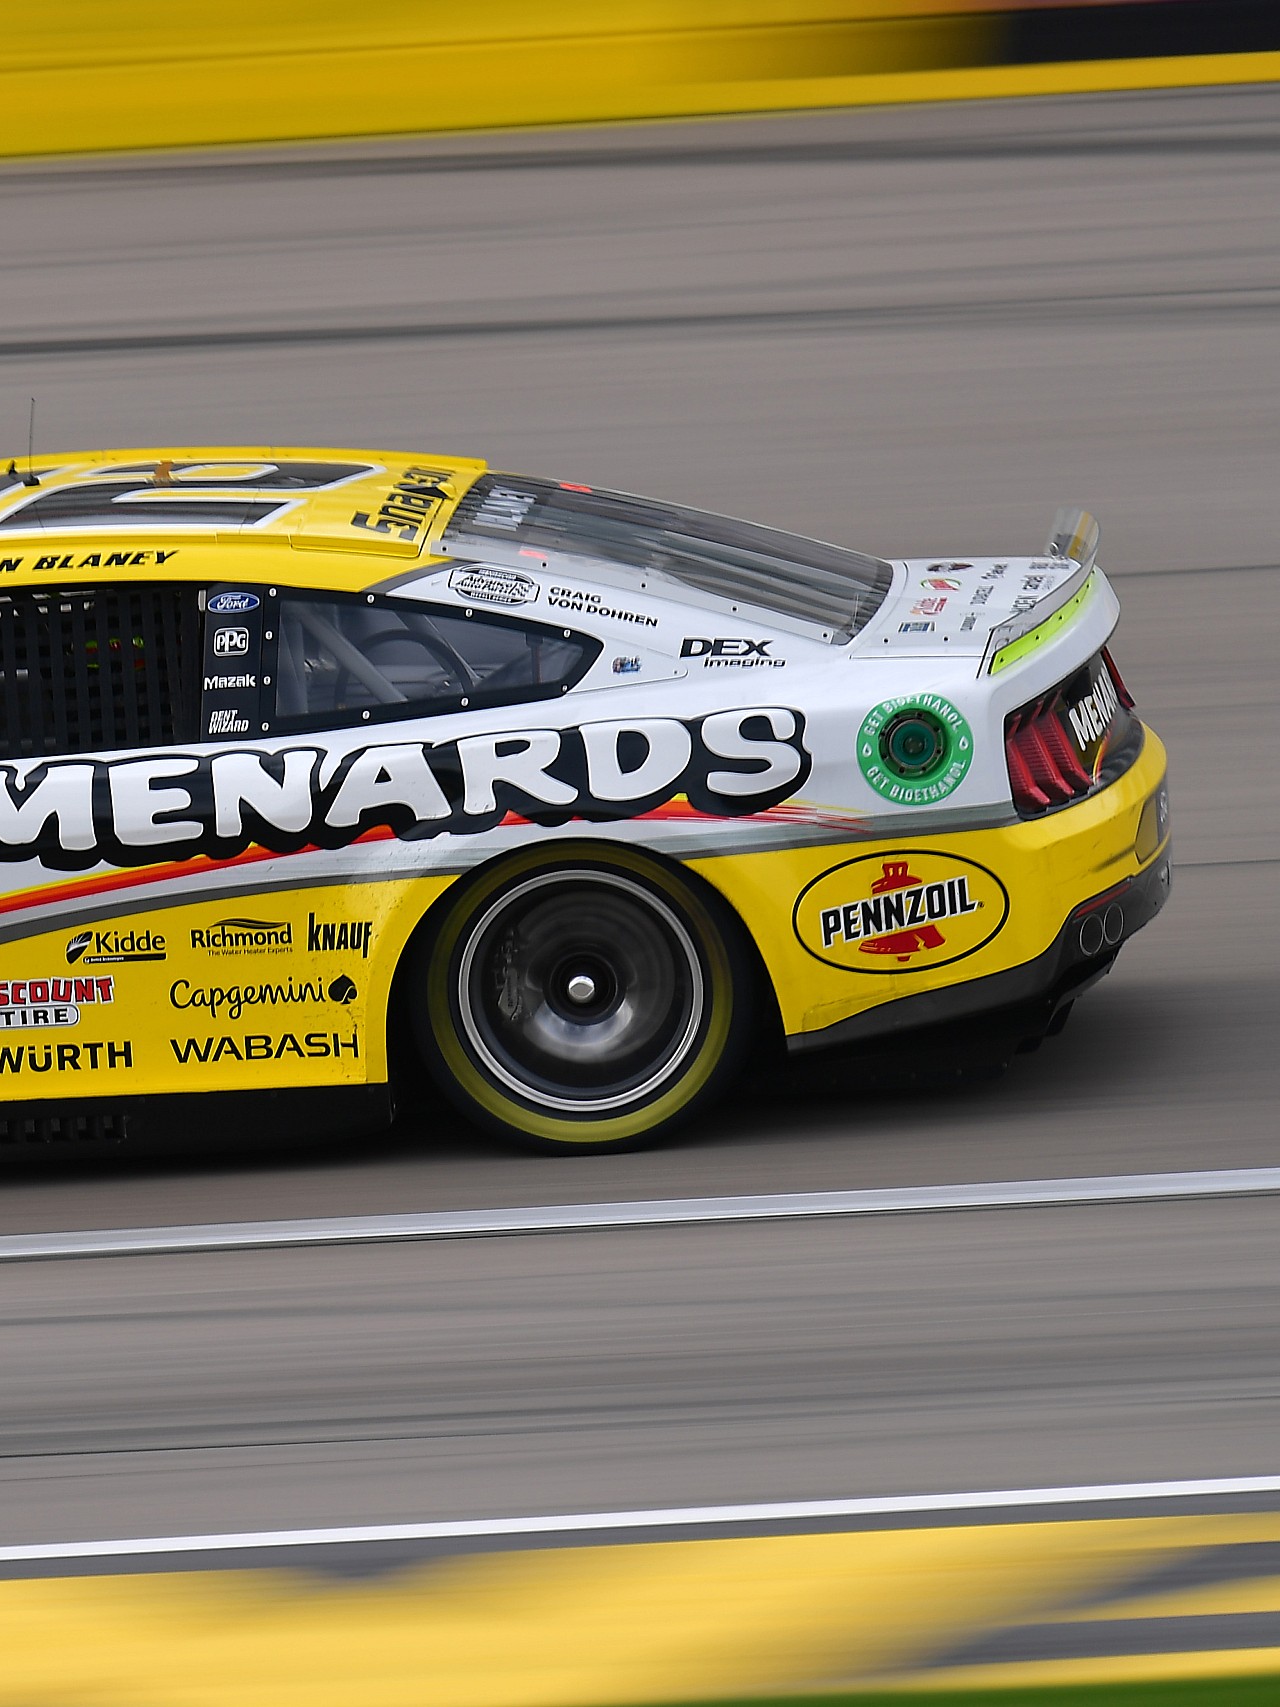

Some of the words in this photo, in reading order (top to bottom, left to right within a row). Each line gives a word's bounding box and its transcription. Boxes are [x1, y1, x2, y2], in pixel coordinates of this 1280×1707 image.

[32, 550, 179, 572] BLANEY
[550, 586, 602, 603] CRAIG
[548, 596, 583, 611] VON
[586, 604, 658, 627] DOHREN
[216, 630, 246, 652] PPG
[679, 637, 774, 658] DEX
[704, 657, 787, 668] imaging
[203, 674, 257, 690] Mazak
[863, 710, 884, 736] GET
[882, 693, 964, 734] BIOETHANOL
[866, 766, 890, 790] GET
[888, 760, 967, 803] BIOETHANOL
[820, 875, 979, 949] PENNZOIL
[95, 930, 166, 953] Kidde
[190, 923, 293, 948] Richmond
[208, 949, 220, 957] The
[243, 947, 266, 955] Heater
[267, 946, 293, 955] Experts
[169, 975, 326, 1020] Capgemini
[0, 1006, 70, 1026] TIRE
[170, 1033, 359, 1064] WABASH
